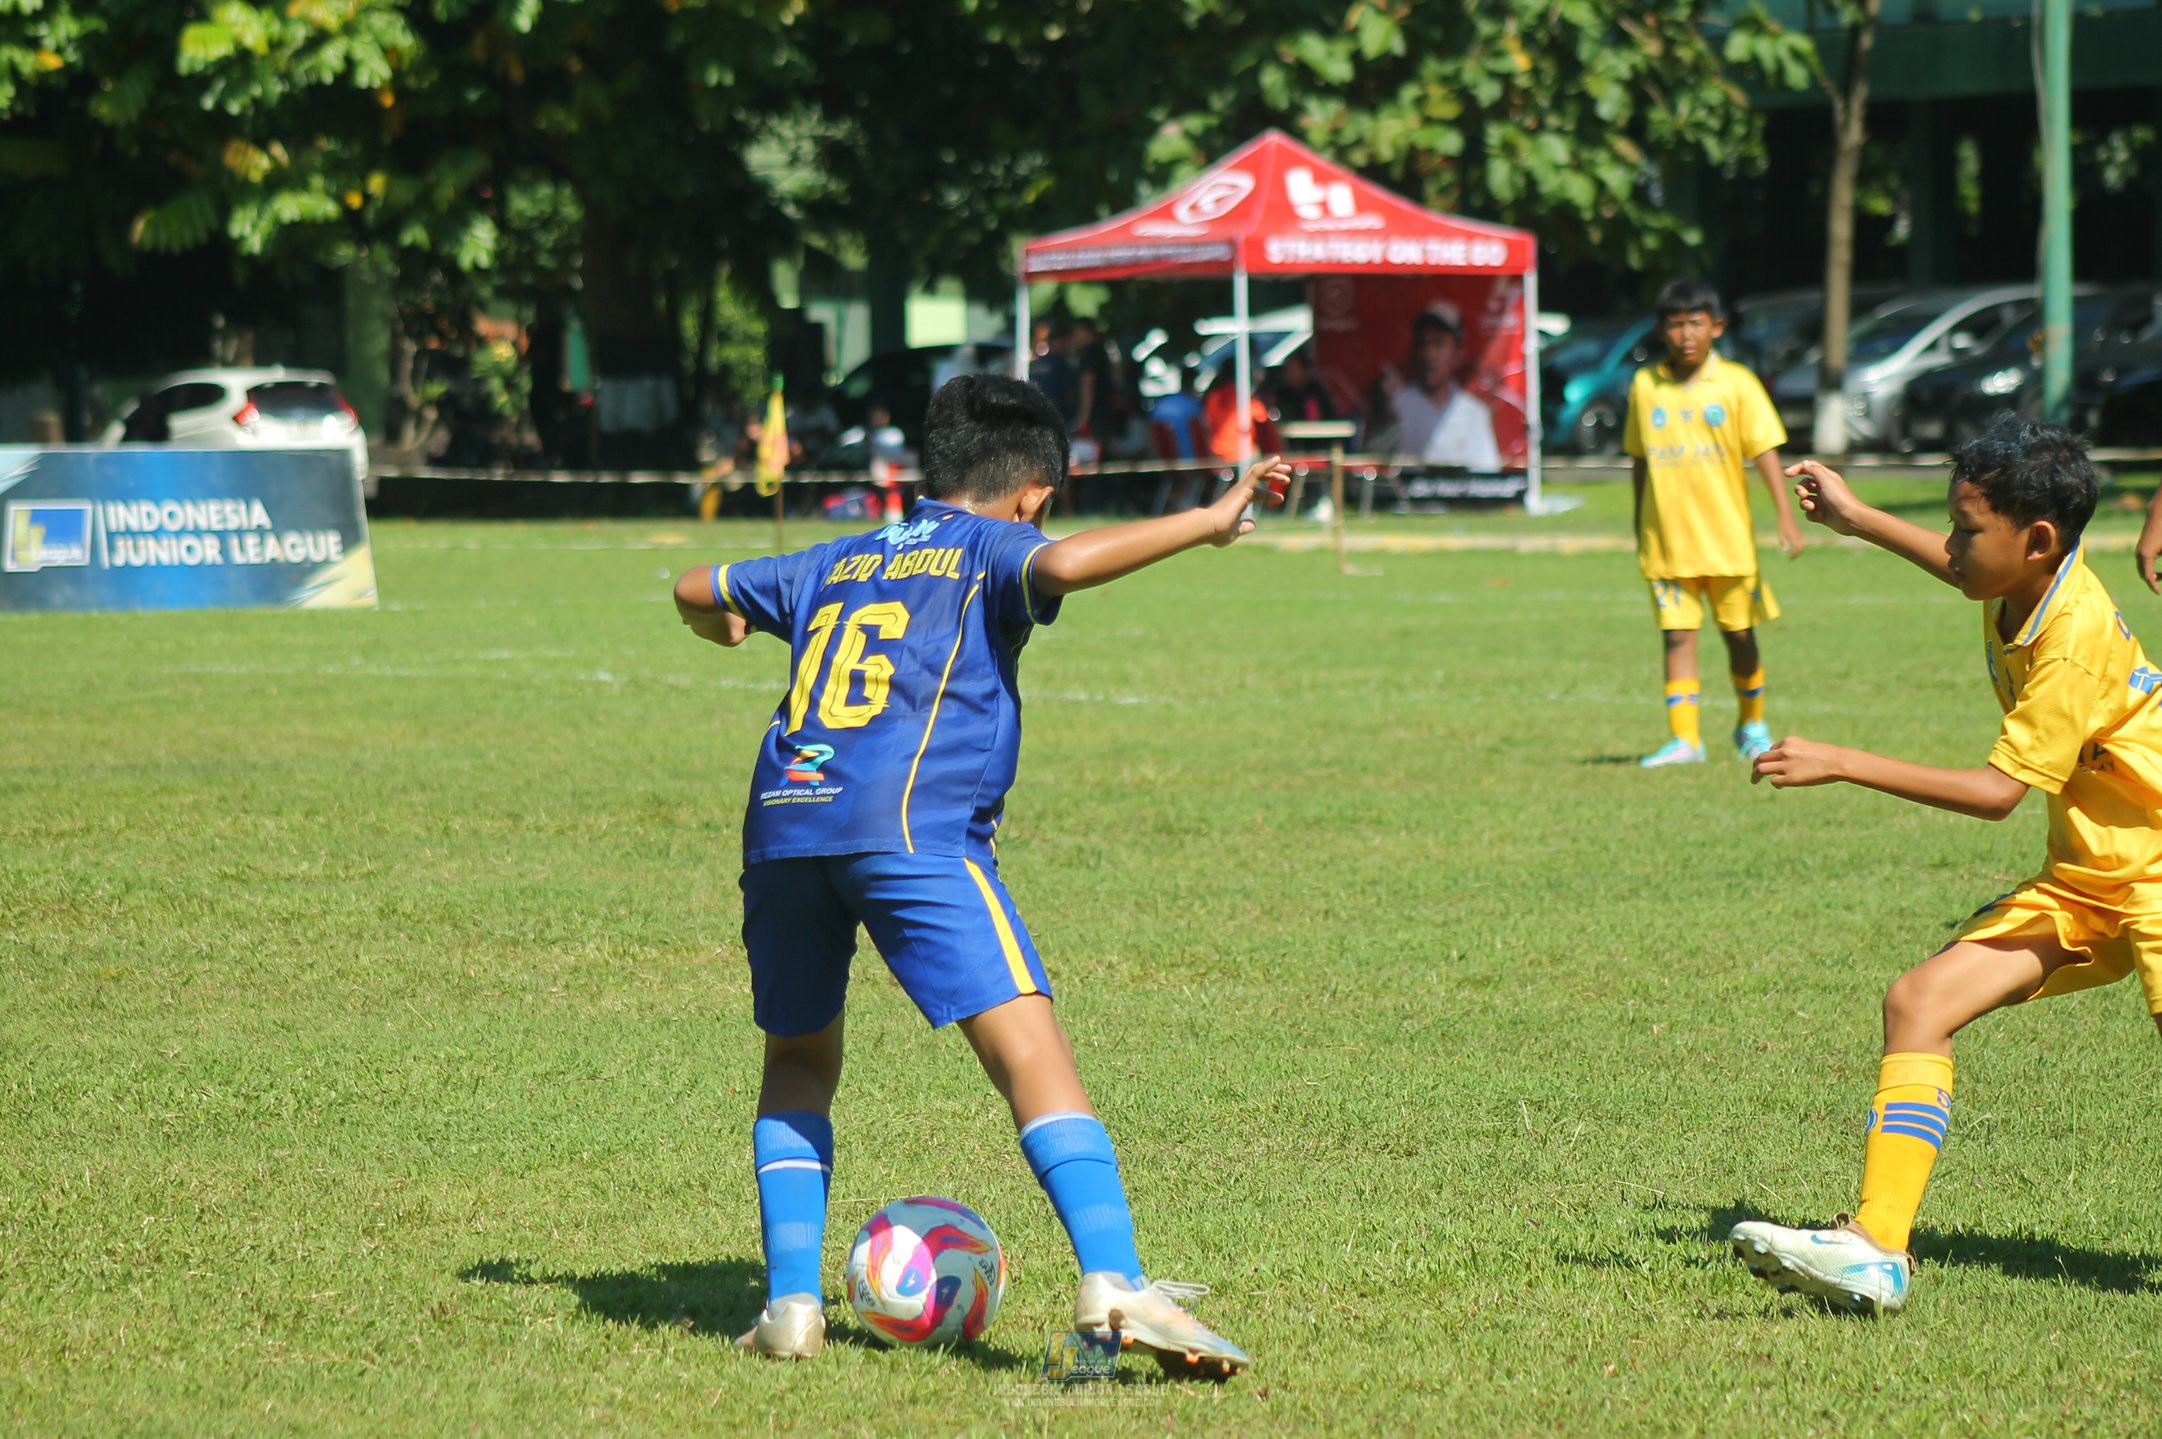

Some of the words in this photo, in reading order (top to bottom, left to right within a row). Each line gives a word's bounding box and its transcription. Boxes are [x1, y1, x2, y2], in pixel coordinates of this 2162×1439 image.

[106, 499, 272, 533] INDONESIA
[112, 532, 224, 567] JUNIOR
[228, 530, 345, 565] LEAGUE
[882, 547, 963, 580] ABDUL
[785, 601, 911, 737] 16
[781, 788, 814, 797] OPTICAL
[815, 787, 843, 796] GROUP
[791, 796, 834, 804] EXCELLENCE
